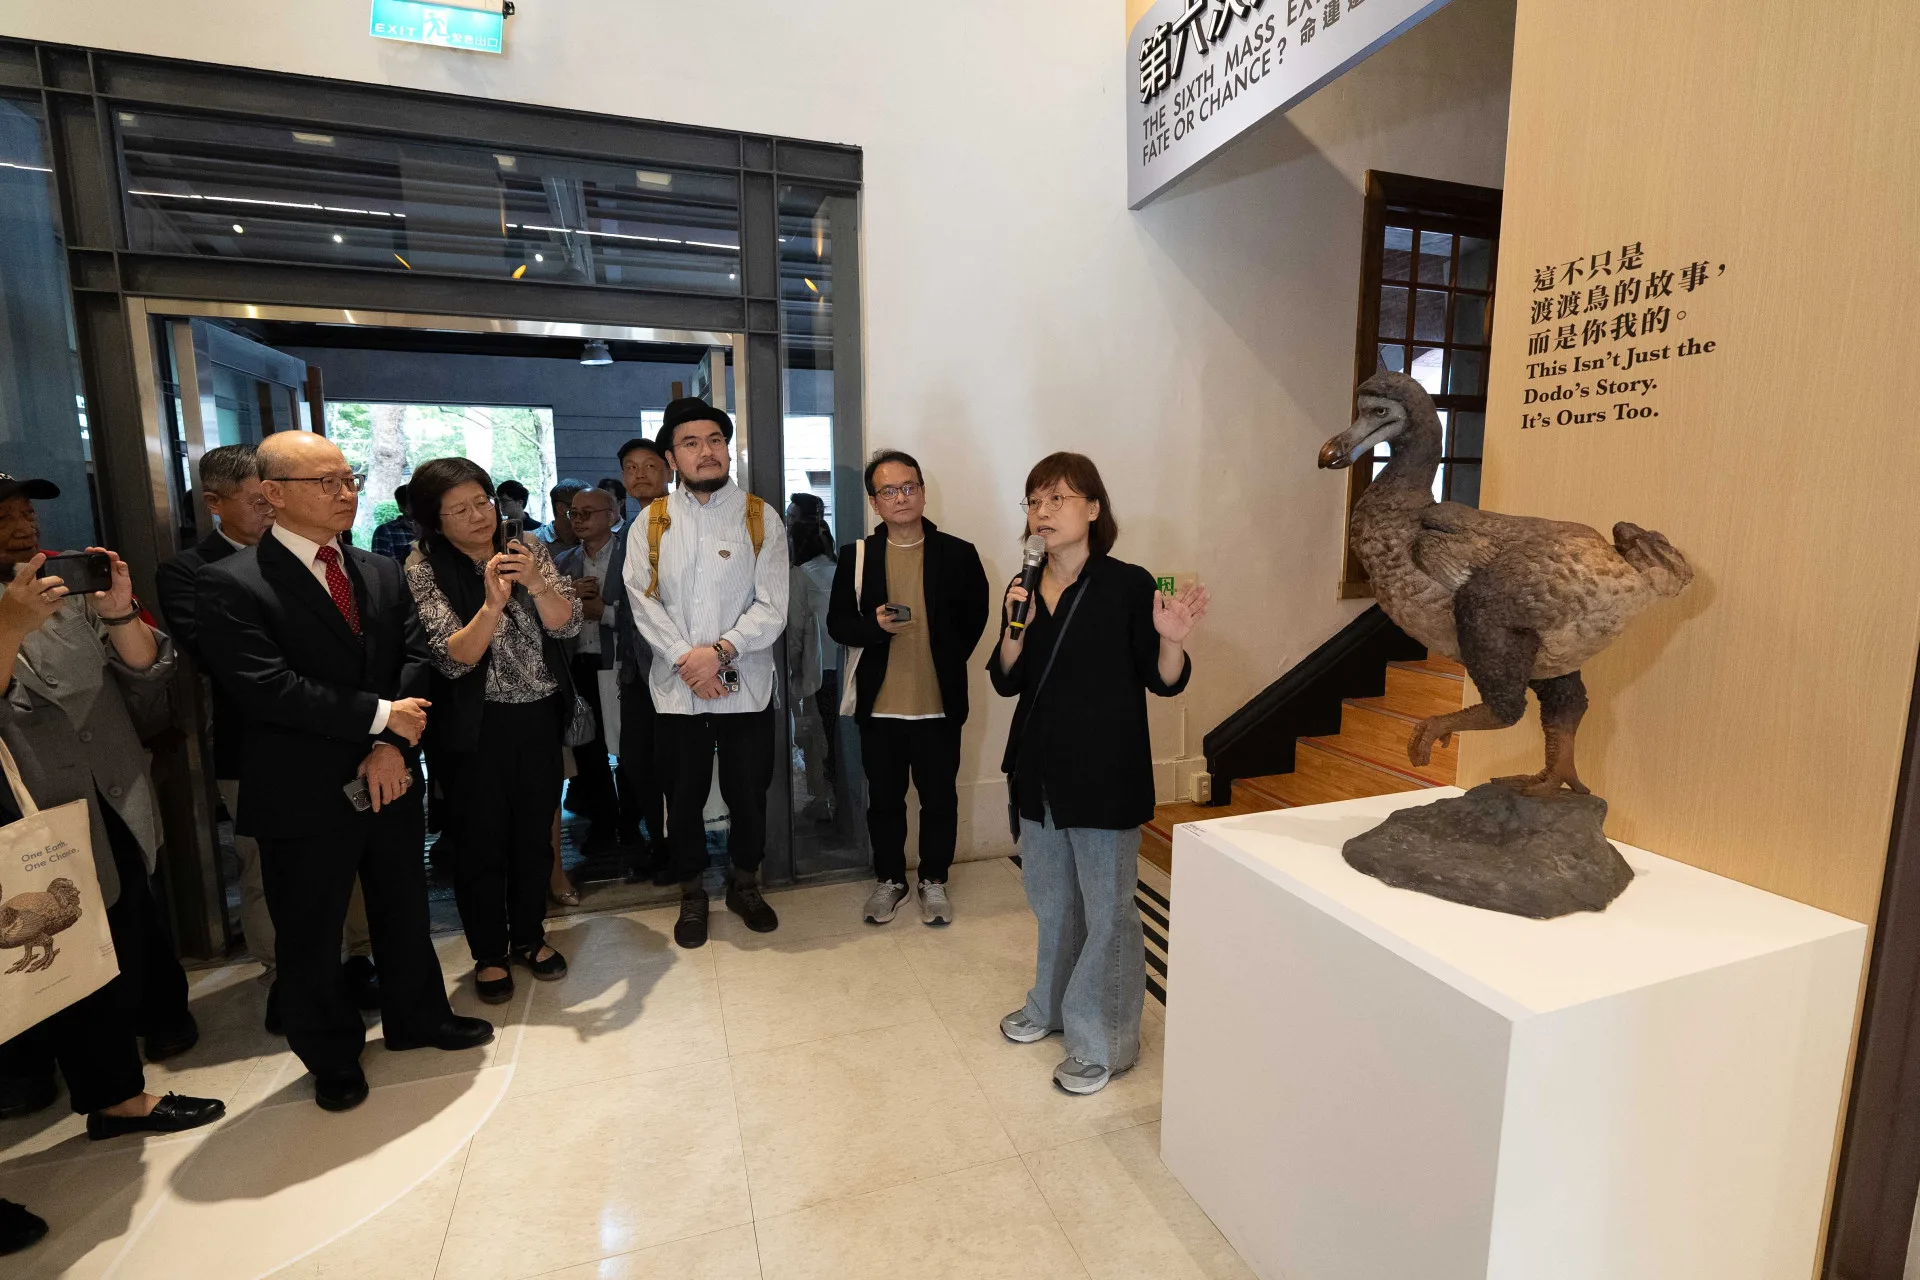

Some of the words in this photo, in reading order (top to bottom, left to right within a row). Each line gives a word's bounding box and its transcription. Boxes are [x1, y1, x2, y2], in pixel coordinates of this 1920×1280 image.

[375, 23, 416, 37] EXIT
[1143, 105, 1165, 140] THE
[1174, 64, 1214, 116] SIXTH
[1225, 14, 1275, 77] MASS
[1143, 134, 1170, 166] FATE
[1174, 110, 1194, 141] OR
[1533, 241, 1644, 293] 這不只是
[1528, 305, 1687, 356] 而是你我的。
[1526, 360, 1567, 380] This
[1621, 344, 1671, 371] Just
[1677, 337, 1716, 358] the
[1596, 378, 1658, 396] Story.
[1556, 408, 1606, 426] Ours
[1613, 402, 1659, 421] Too.
[21, 851, 43, 862] One
[25, 860, 47, 872] One
